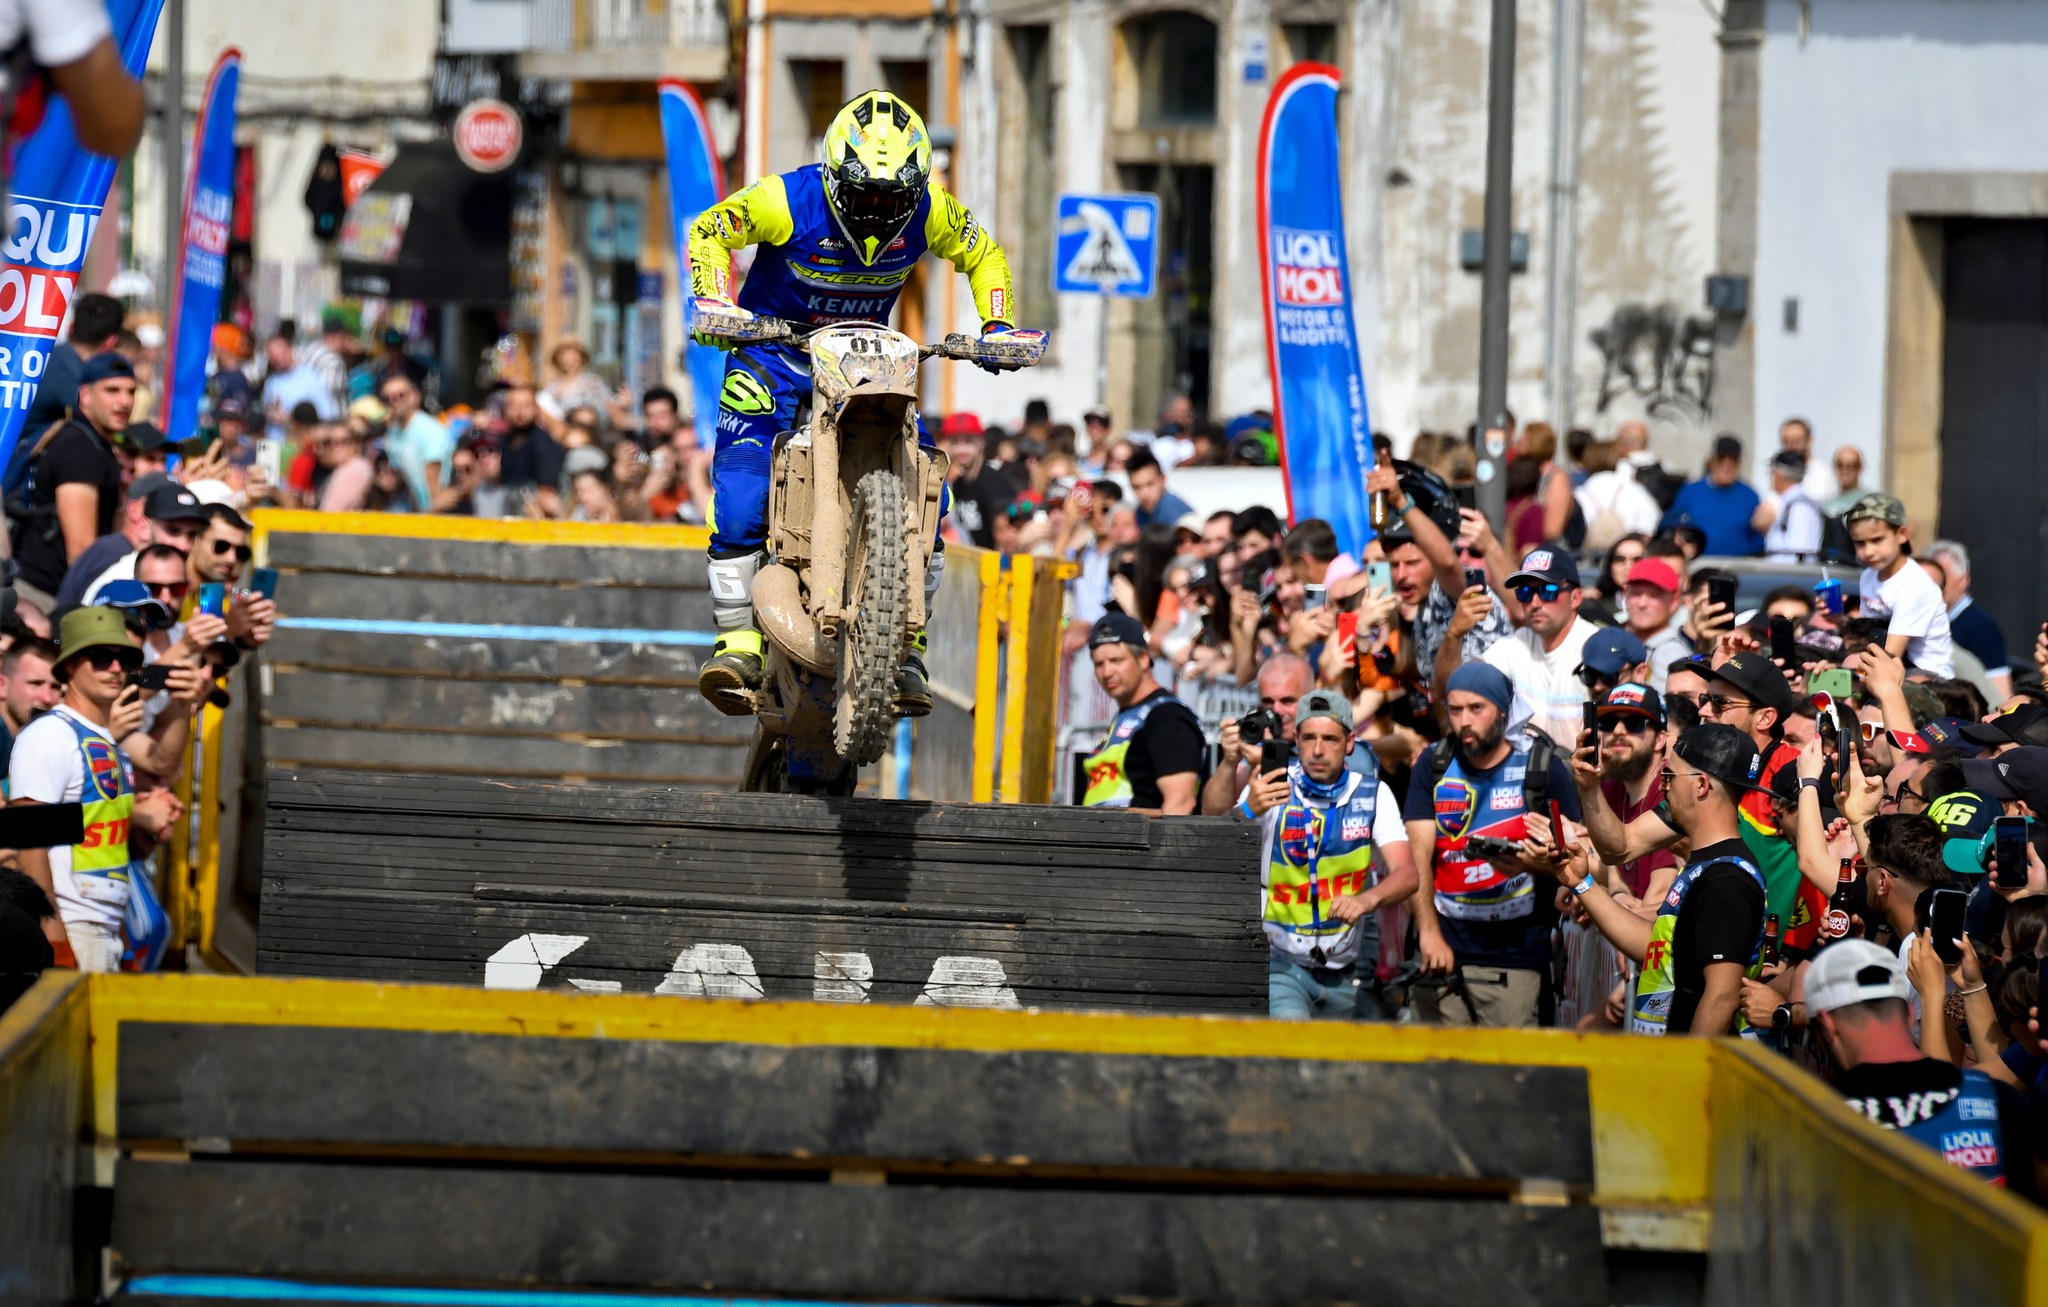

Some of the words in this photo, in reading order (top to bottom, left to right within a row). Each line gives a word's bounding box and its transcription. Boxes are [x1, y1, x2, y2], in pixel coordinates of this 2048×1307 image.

[4, 203, 100, 266] QUI
[1276, 234, 1339, 268] LIQU
[1278, 266, 1342, 301] MOL
[0, 269, 73, 330] OL
[807, 295, 890, 314] KENNY
[850, 338, 882, 354] 01
[1492, 787, 1521, 798] LIQUI
[1492, 797, 1522, 809] MOLY
[1342, 817, 1369, 828] LIQUI
[1932, 803, 1977, 826] 46
[1342, 827, 1370, 840] MOLY
[1464, 863, 1494, 884] 29
[1273, 868, 1370, 904] STAFF
[1643, 941, 1666, 971] FF
[1944, 1130, 1993, 1150] LIQUI
[1945, 1148, 1996, 1168] MOLY
